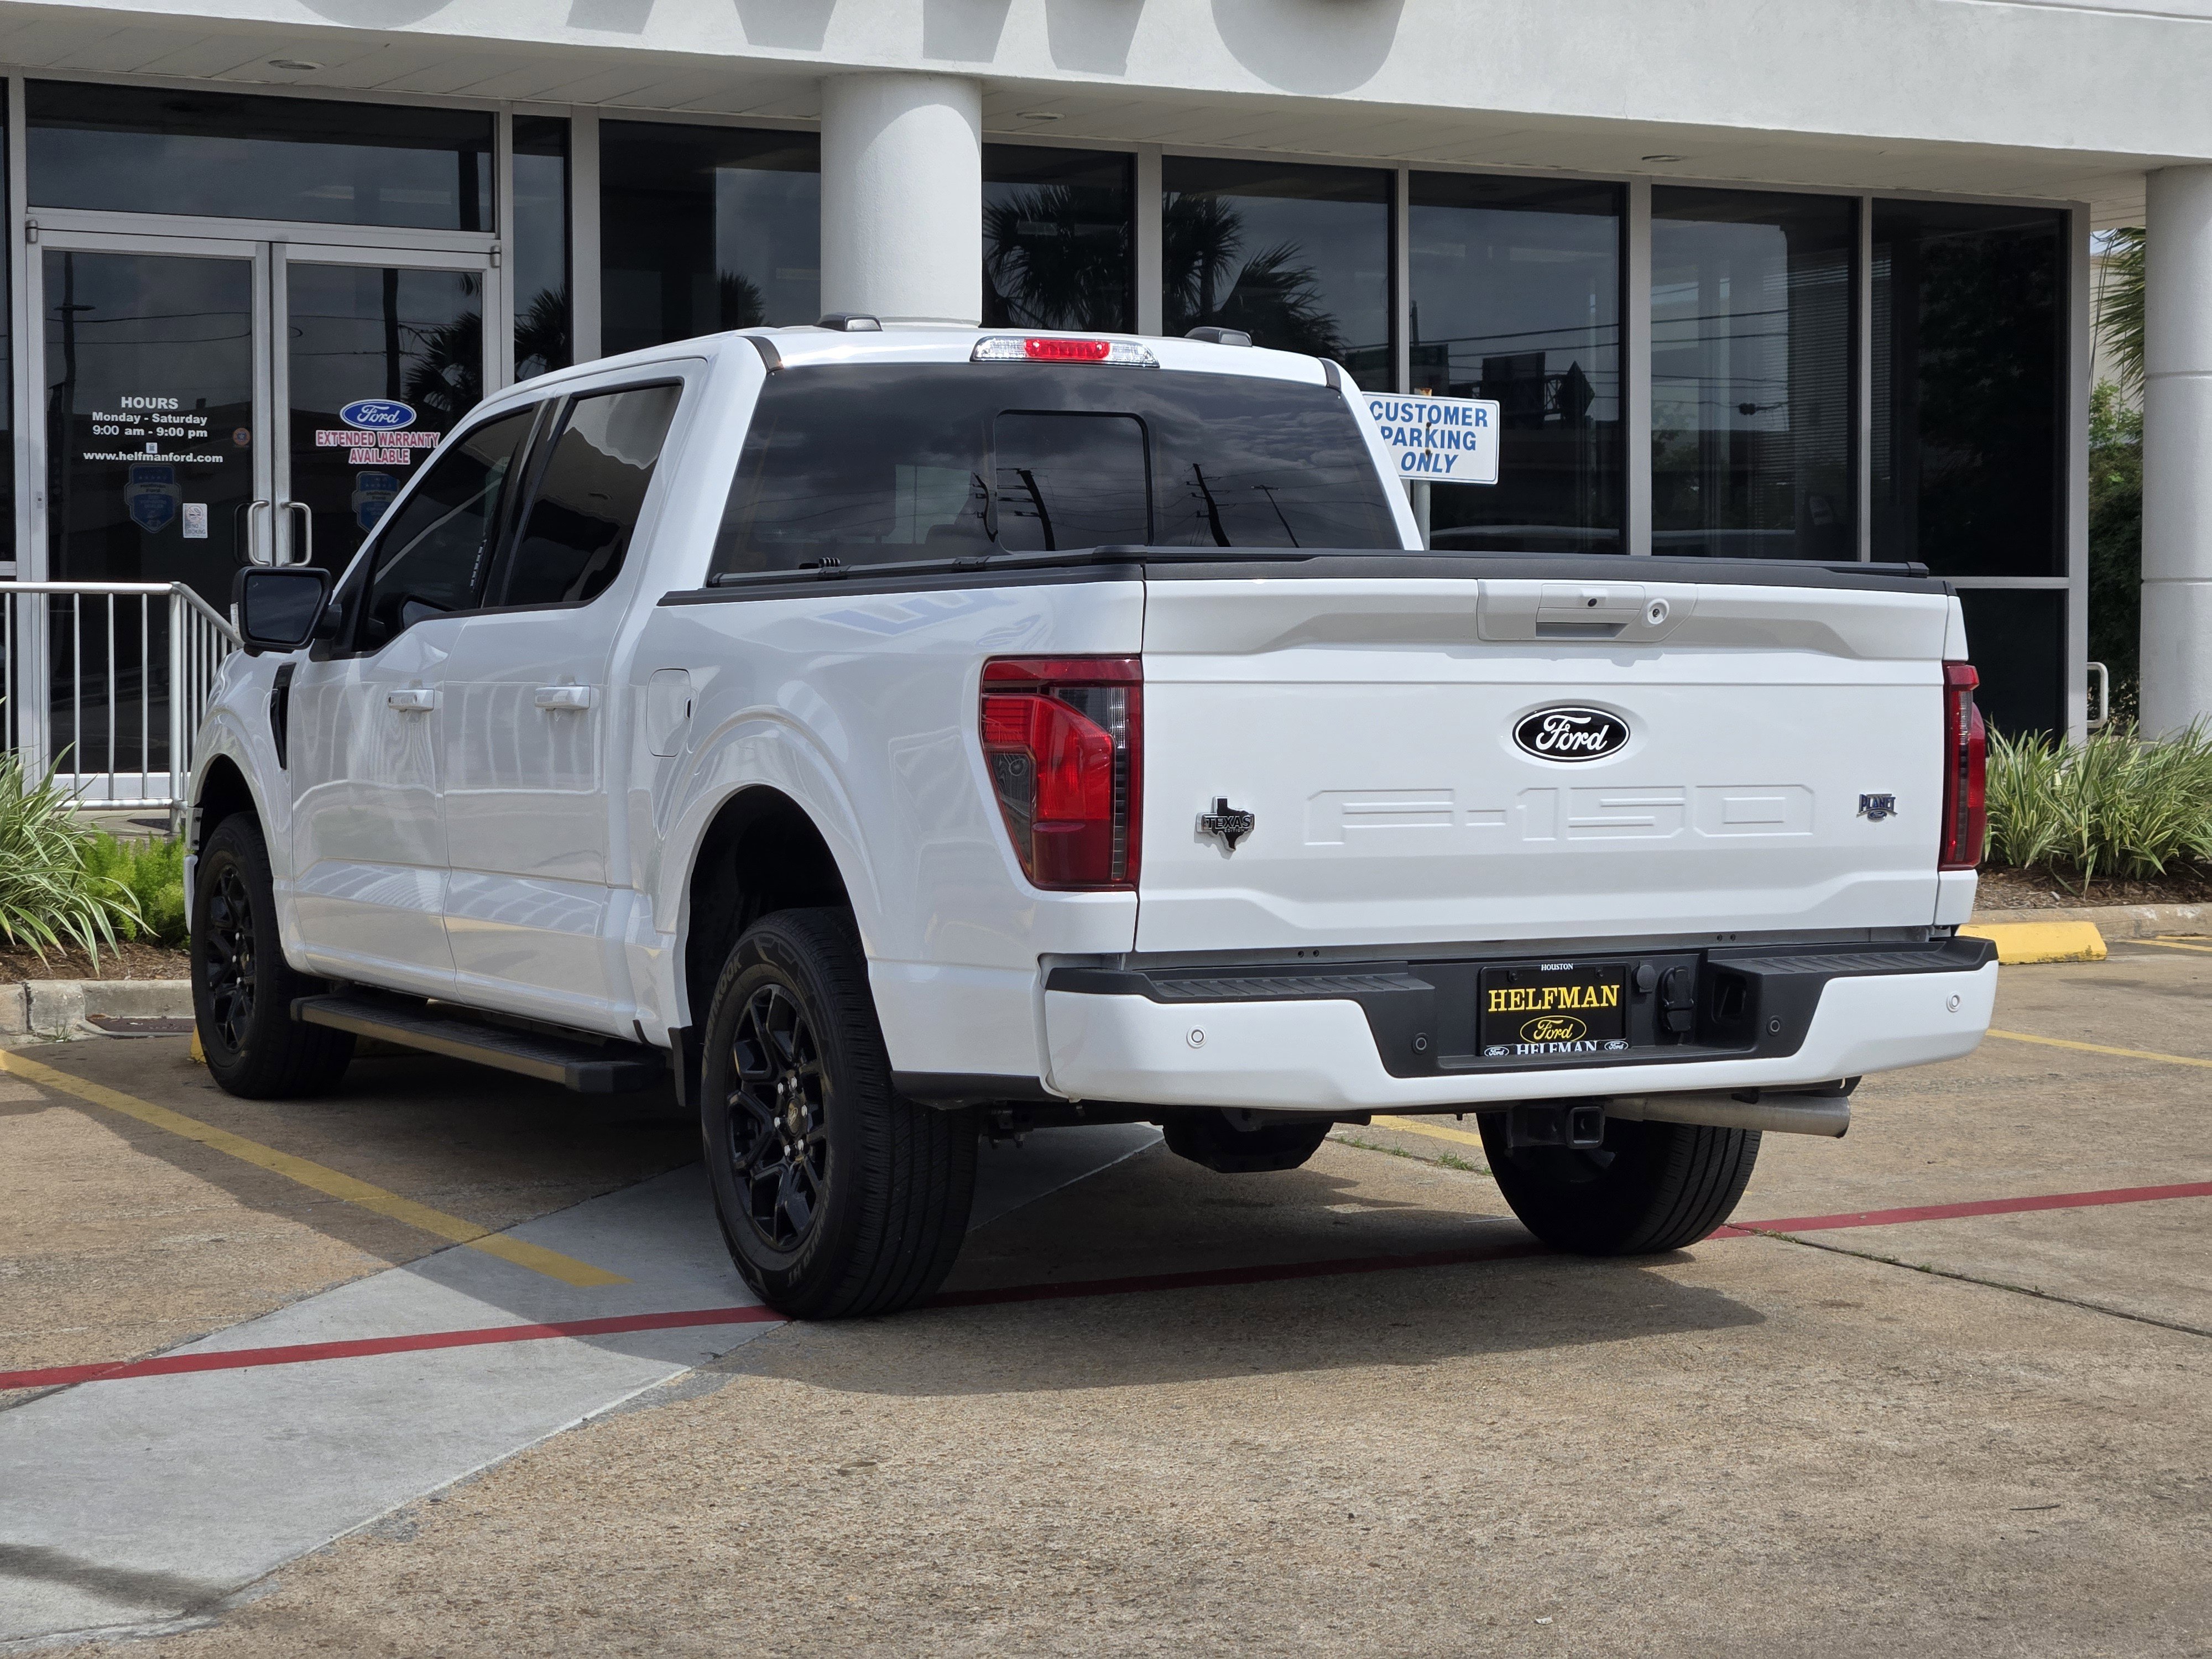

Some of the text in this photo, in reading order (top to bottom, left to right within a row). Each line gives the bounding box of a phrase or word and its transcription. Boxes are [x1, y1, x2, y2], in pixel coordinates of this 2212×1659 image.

[121, 397, 178, 409] HOURS
[92, 411, 140, 424] Monday
[152, 414, 207, 426] Saturday
[357, 405, 400, 423] Ford
[1369, 401, 1488, 427] CUSTOMER
[92, 425, 119, 435] 9:00
[124, 427, 144, 436] am
[156, 427, 184, 437] 9:00
[188, 430, 207, 439] pm
[317, 431, 439, 447] EXTENDED WARRANTY
[1381, 426, 1476, 451] PARKING
[83, 452, 223, 463] www.helfmanford.com
[350, 449, 409, 464] AVAILABLE
[1401, 451, 1458, 473] ONLY
[1536, 715, 1609, 750] Ford
[1205, 815, 1251, 829] TEXAS
[1304, 784, 1815, 845] F-150
[1488, 985, 1620, 1012] HELFMAN
[1533, 1019, 1574, 1040] Ford
